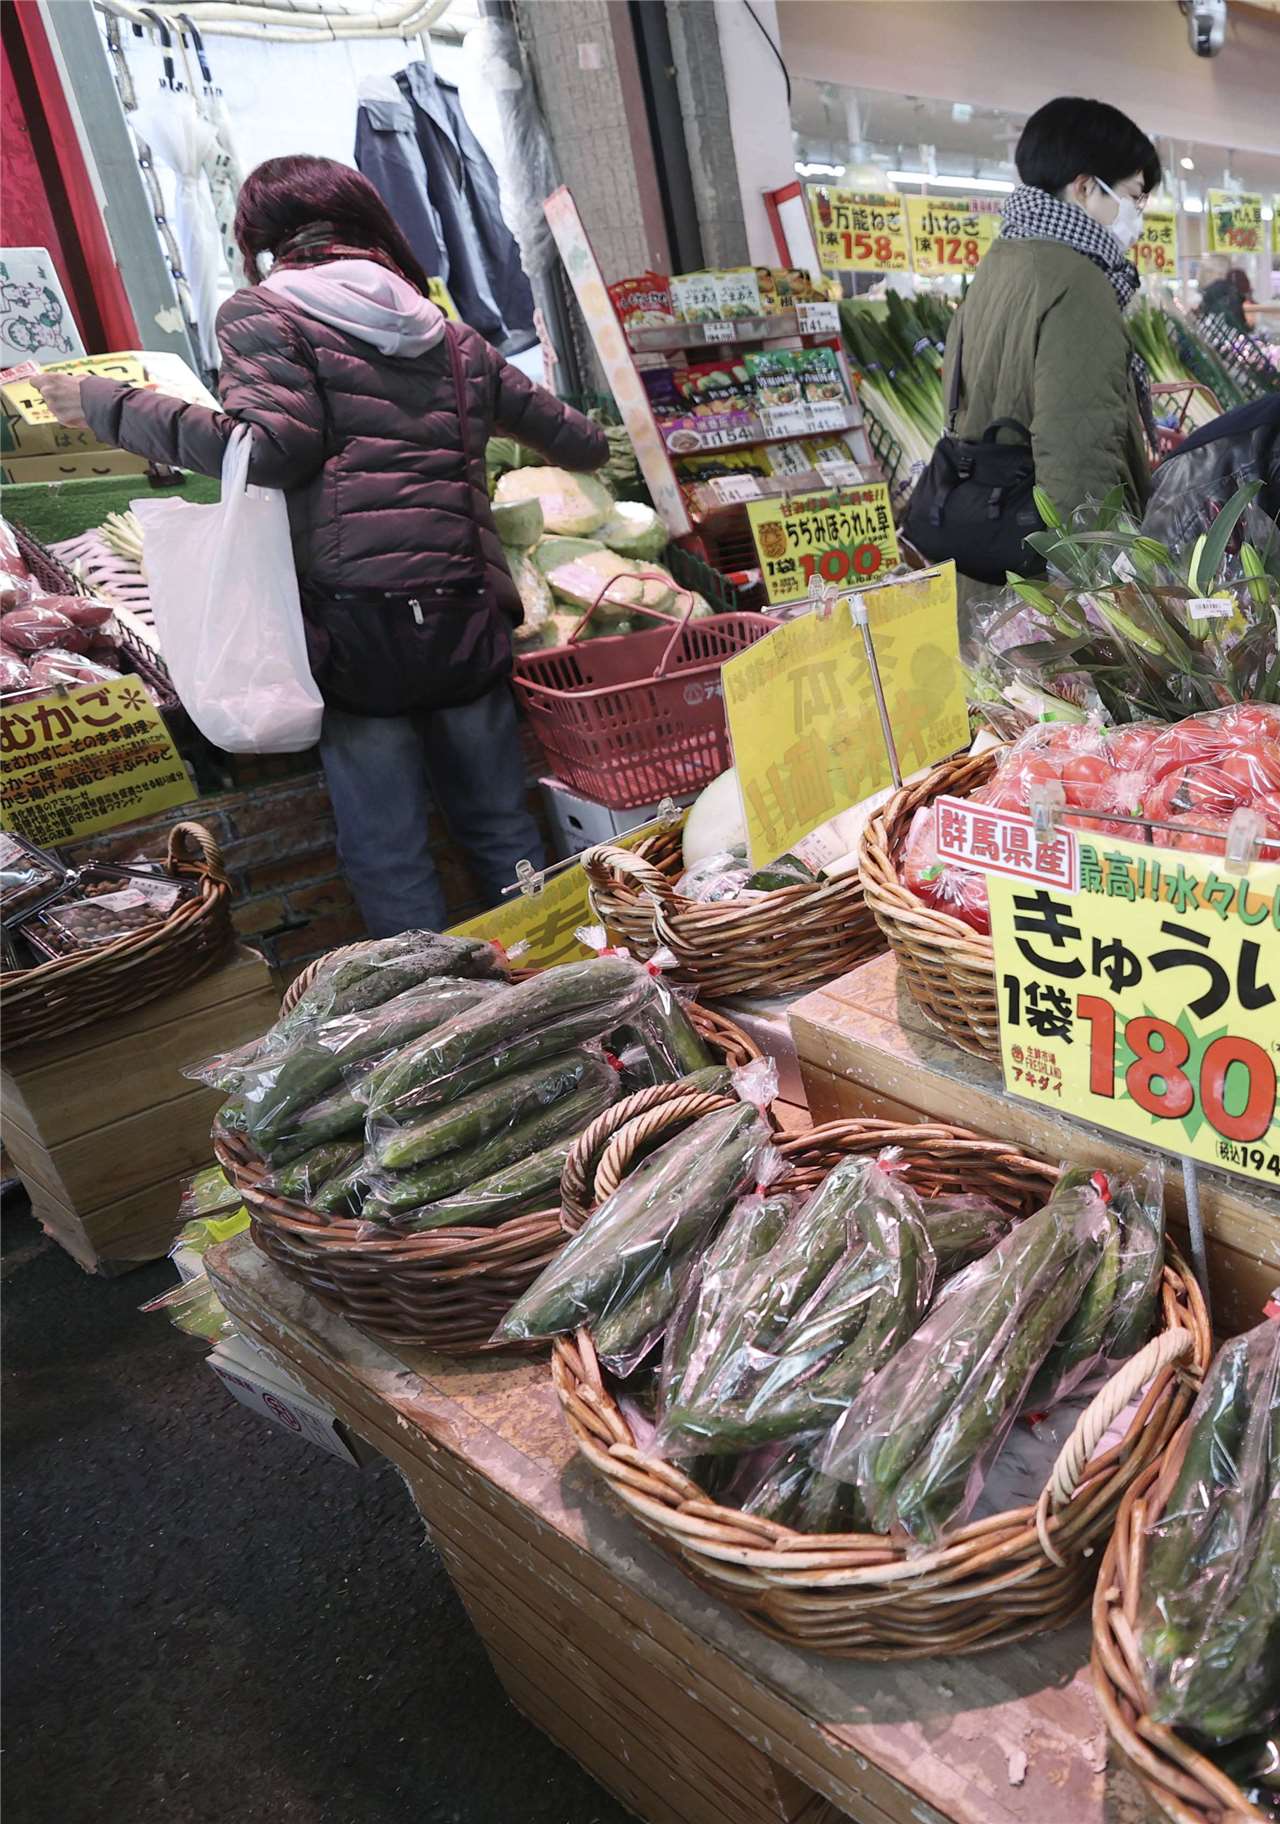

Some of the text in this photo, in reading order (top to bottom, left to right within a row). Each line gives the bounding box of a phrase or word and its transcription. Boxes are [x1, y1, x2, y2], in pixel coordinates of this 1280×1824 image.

[834, 206, 901, 233] 万能ねぎ
[922, 211, 980, 237] 小ねぎ
[934, 236, 980, 265] 128
[785, 504, 889, 548] ちぢみほうれん草
[939, 808, 1068, 878] 群馬県産
[1003, 974, 1075, 1045] 1袋
[1011, 1065, 1063, 1098] アキダイ
